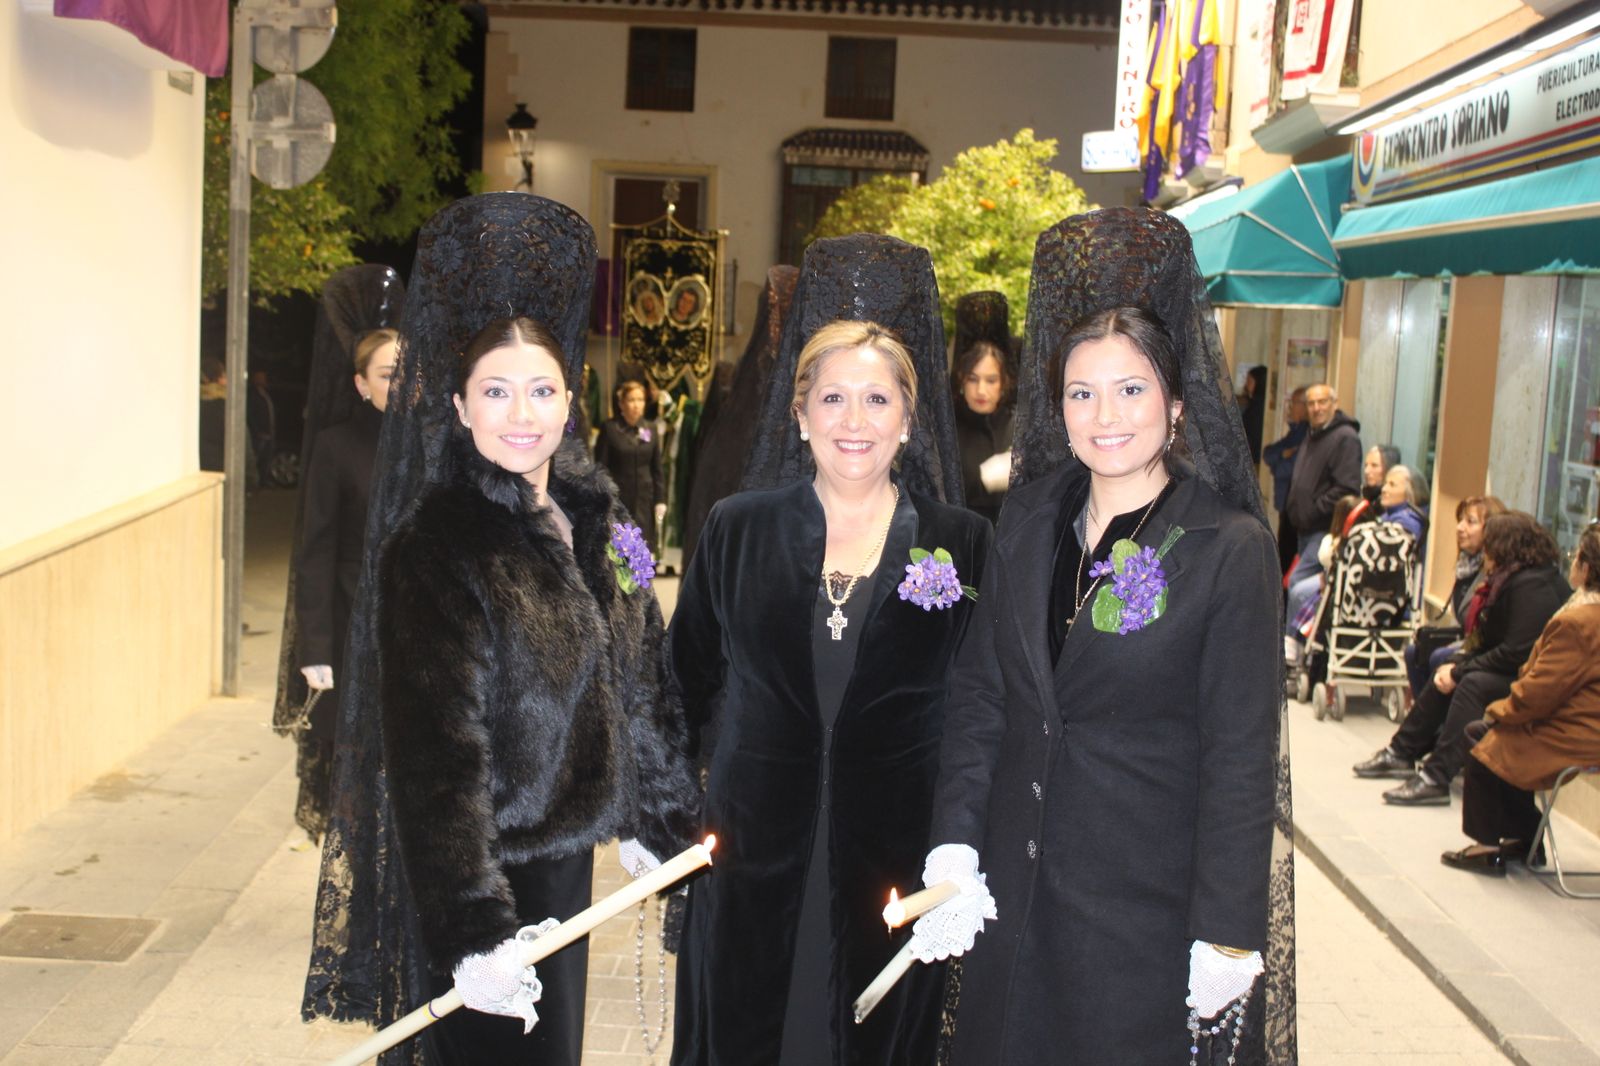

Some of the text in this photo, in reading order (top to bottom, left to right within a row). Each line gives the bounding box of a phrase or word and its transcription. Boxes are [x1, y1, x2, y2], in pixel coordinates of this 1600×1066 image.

[1536, 50, 1600, 95] PUERICULTURA
[1382, 89, 1510, 172] EXPOCENTRO SORIANO
